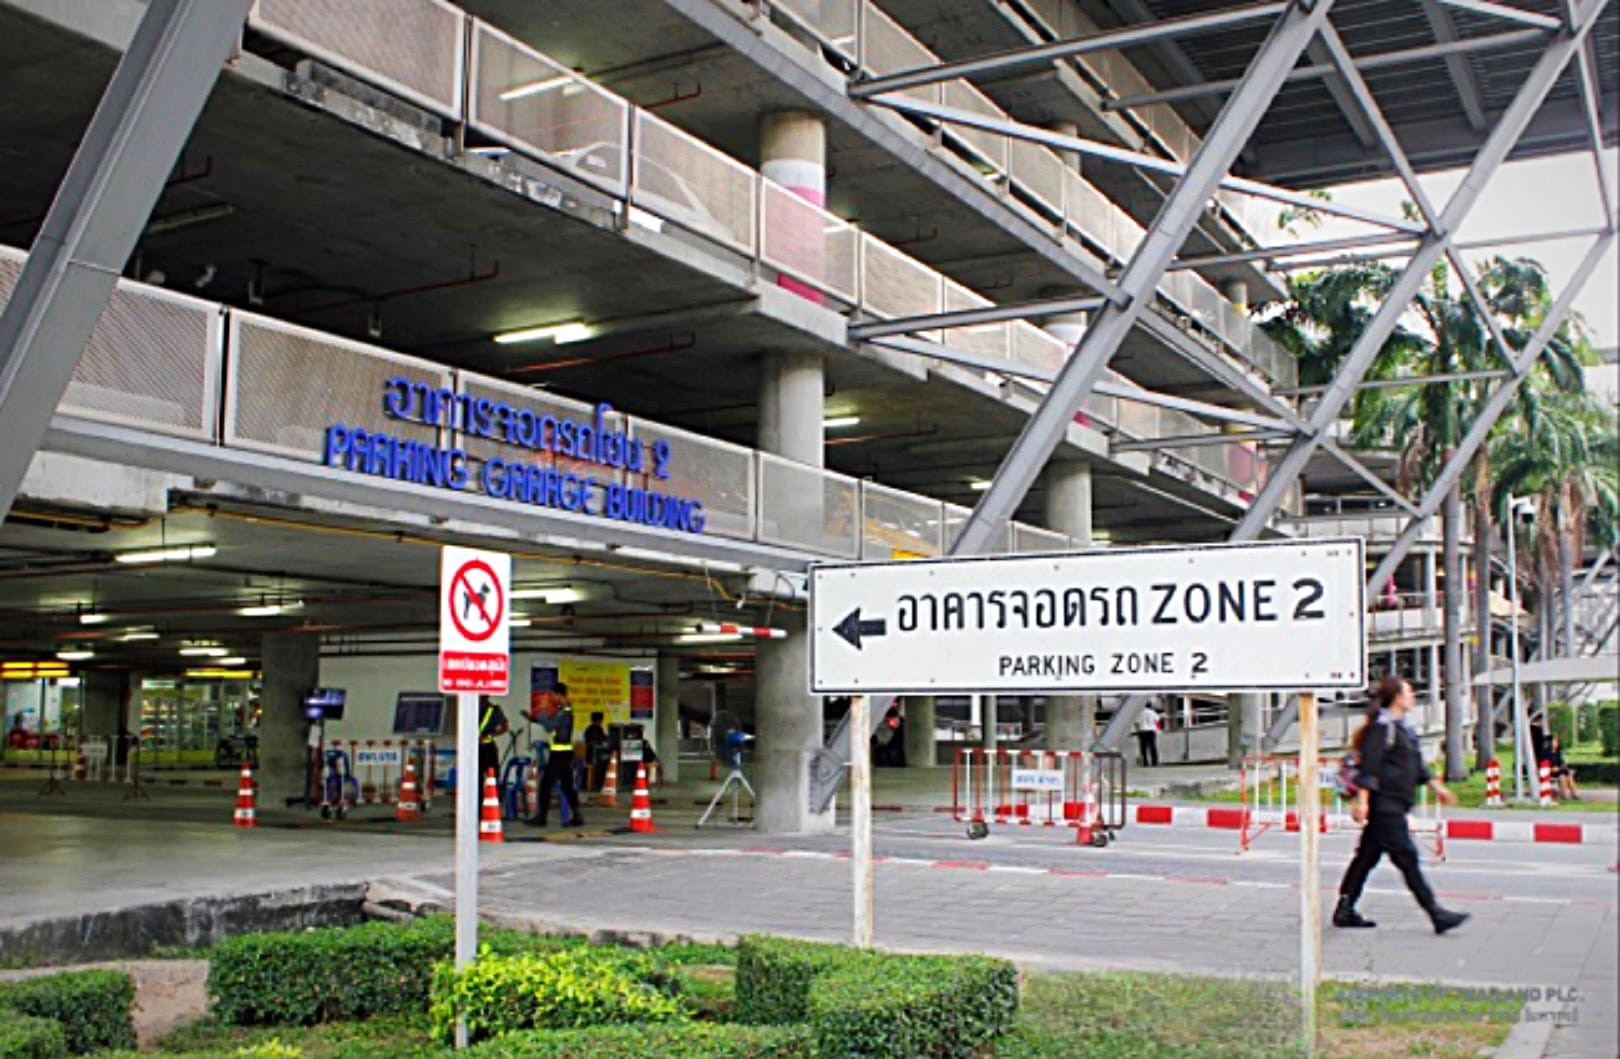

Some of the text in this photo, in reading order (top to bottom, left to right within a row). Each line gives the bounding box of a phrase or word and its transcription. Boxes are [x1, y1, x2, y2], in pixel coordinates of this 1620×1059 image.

[325, 423, 705, 535] PARKING GARAGE BUILDING
[897, 577, 1325, 633] อาคารจอดรถ ZONE 2
[998, 652, 1208, 676] PARKING ZONE 2
